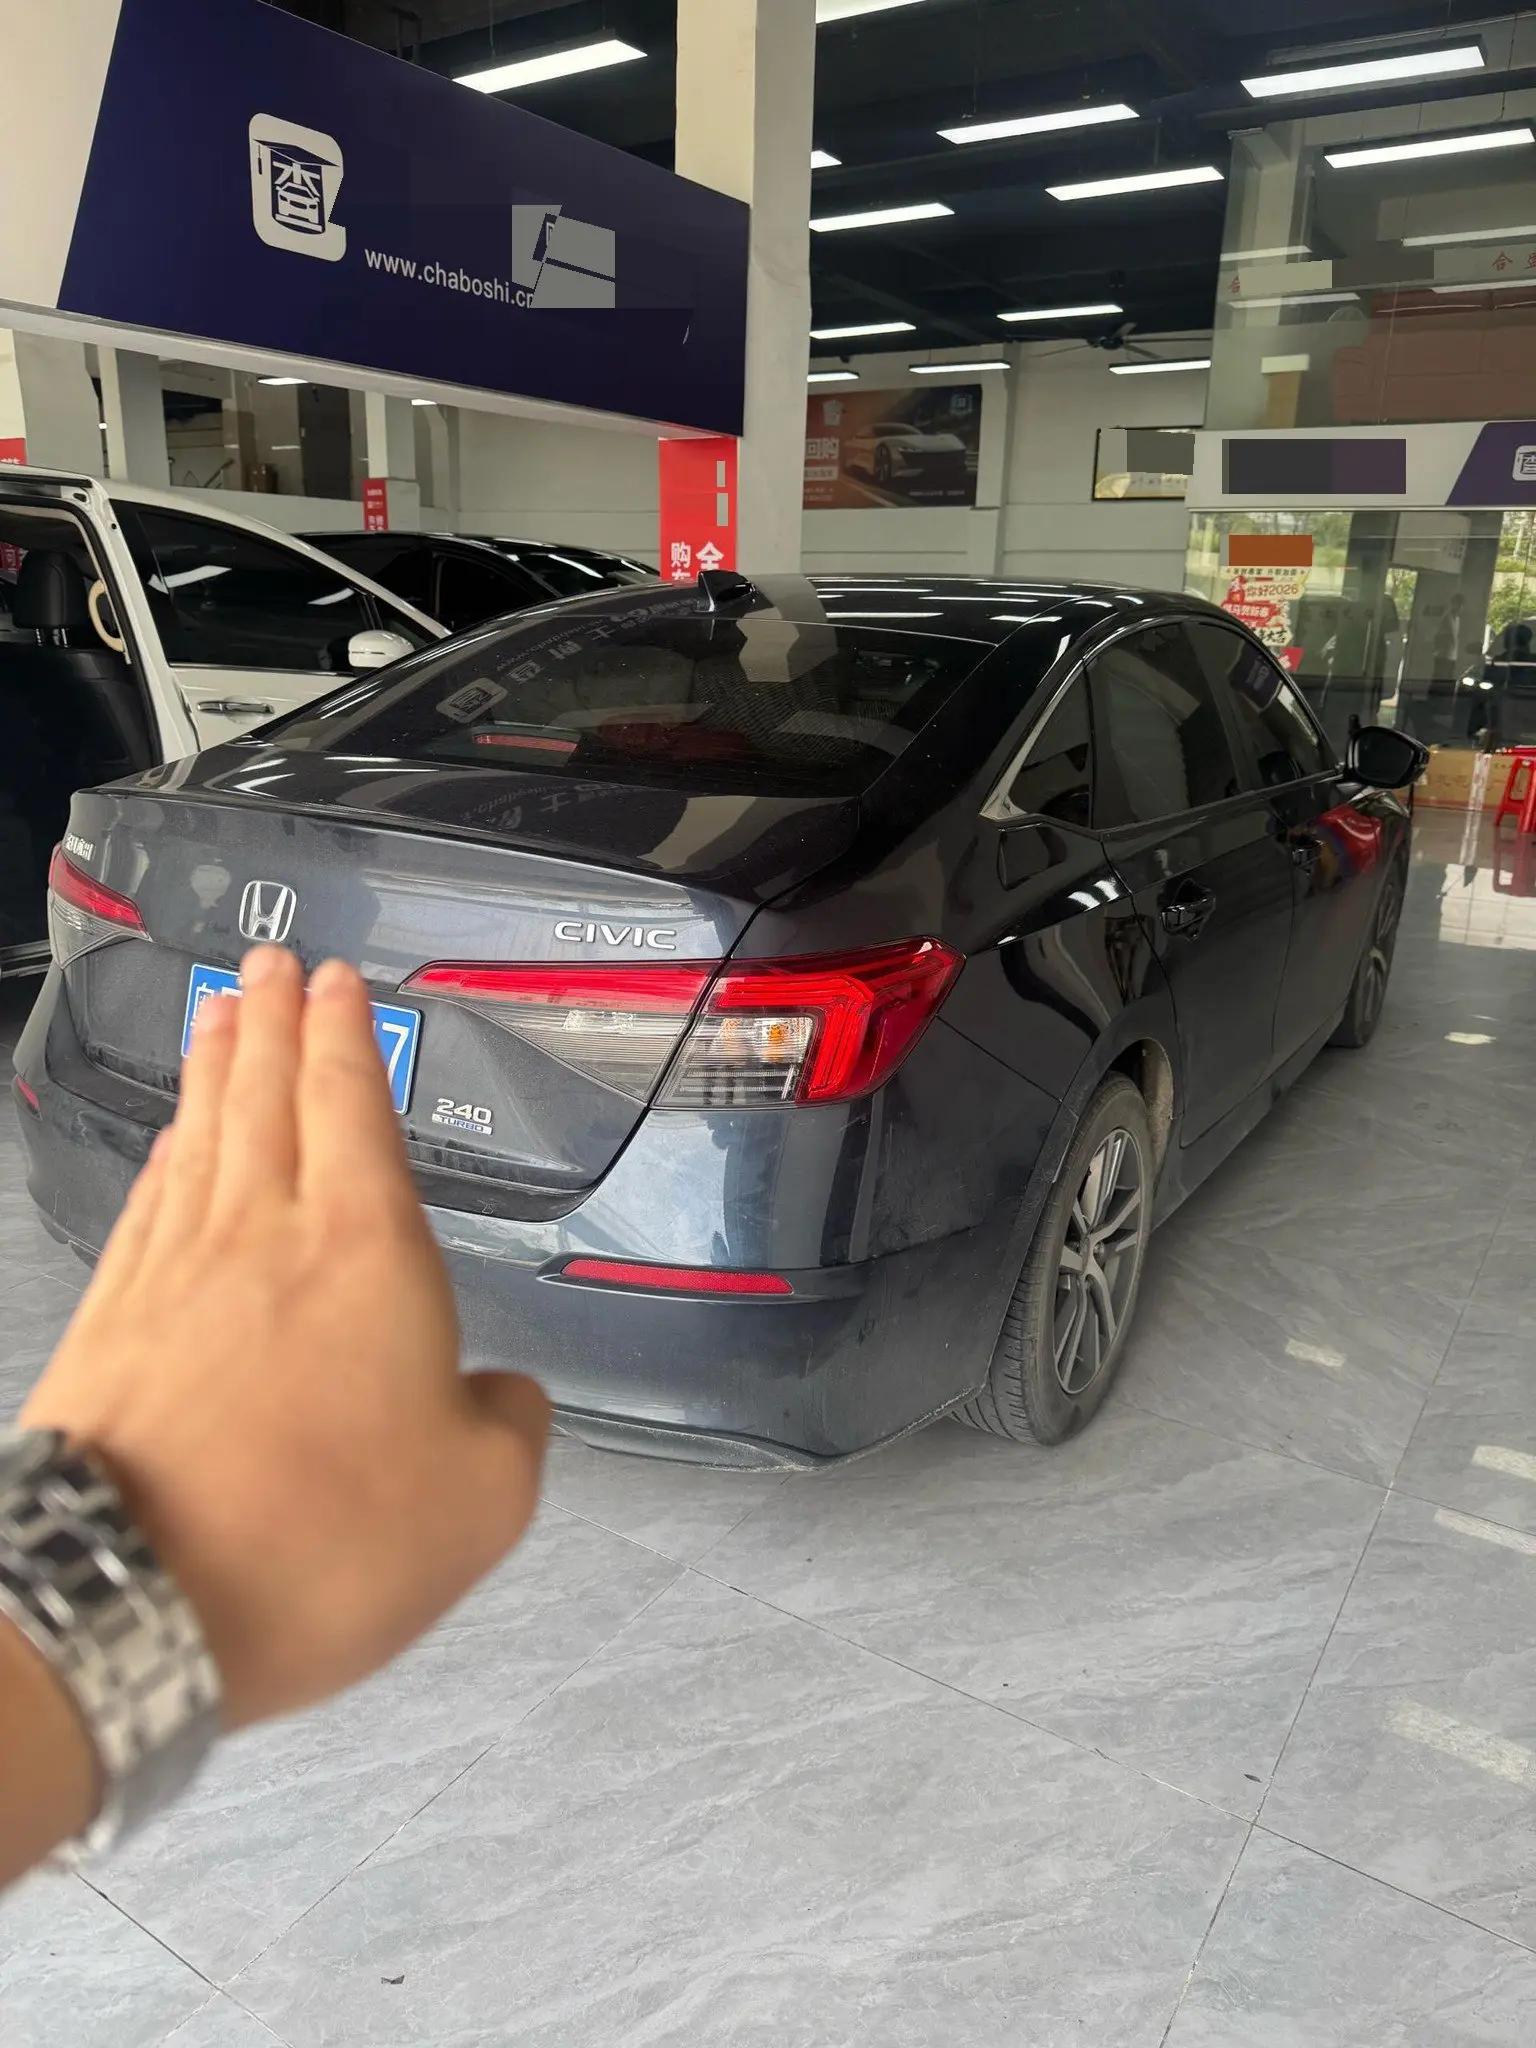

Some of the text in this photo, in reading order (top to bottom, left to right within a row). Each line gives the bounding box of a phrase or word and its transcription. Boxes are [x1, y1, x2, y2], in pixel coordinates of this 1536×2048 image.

[554, 920, 677, 951] CIVIC
[436, 1097, 492, 1124] 240
[437, 1115, 486, 1133] TURBO
